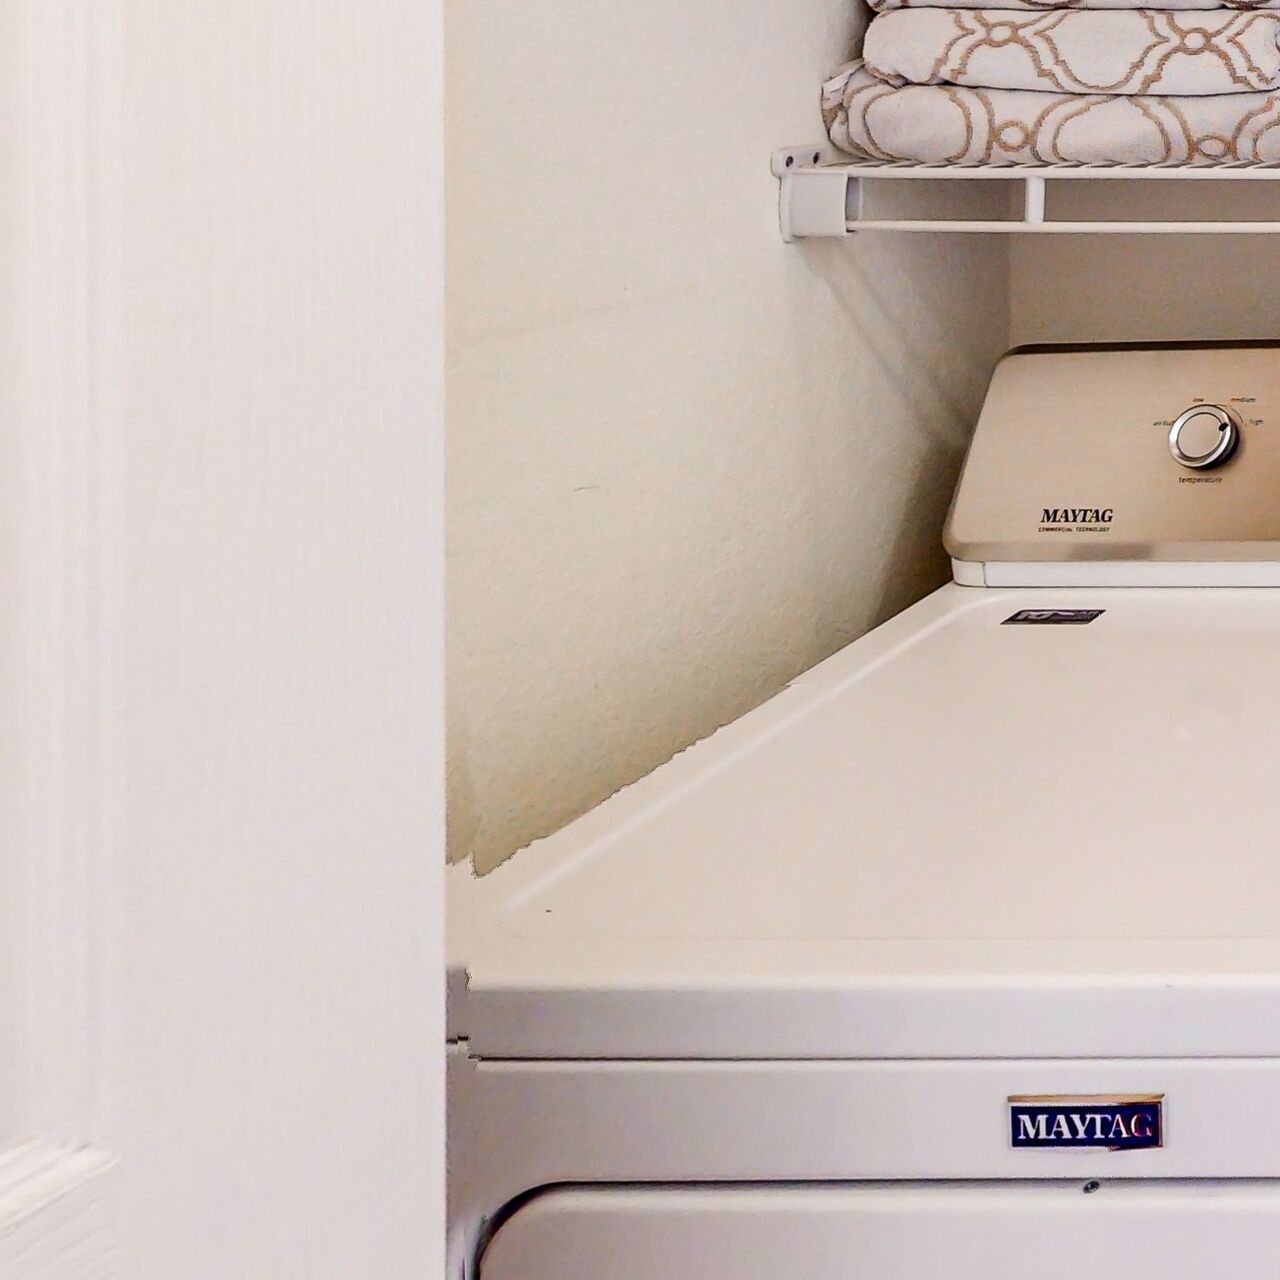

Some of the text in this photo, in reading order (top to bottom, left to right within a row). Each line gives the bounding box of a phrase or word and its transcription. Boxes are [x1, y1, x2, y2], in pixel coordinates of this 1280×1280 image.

[1178, 476, 1223, 484] temperature
[1040, 508, 1114, 523] MAYTAG
[1017, 1113, 1153, 1140] MAYTAG
